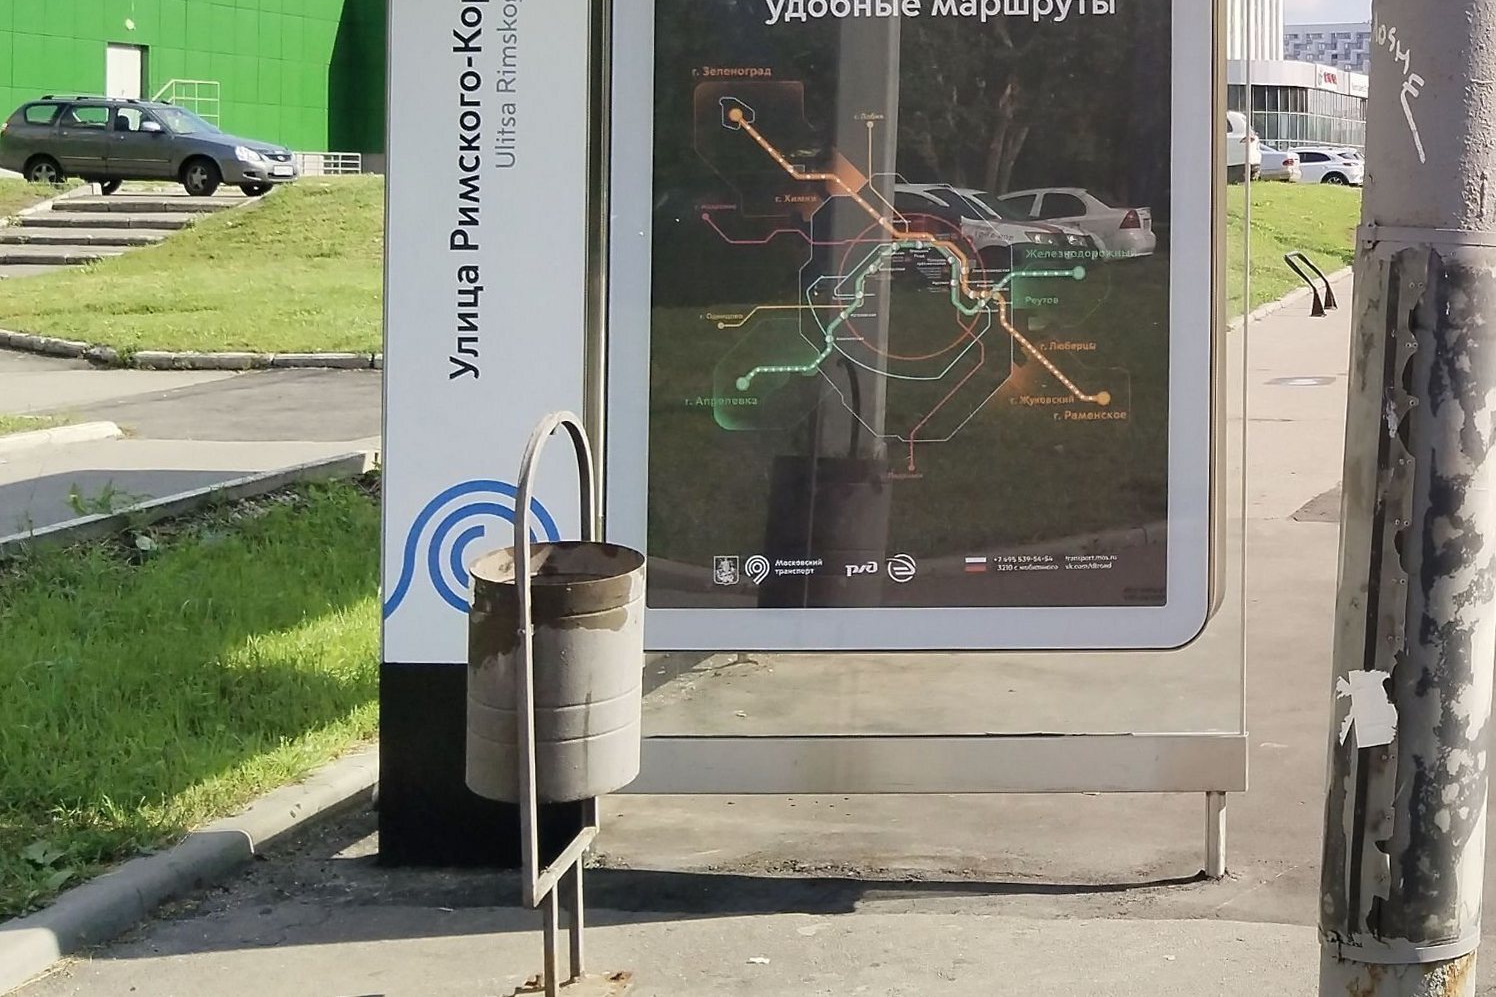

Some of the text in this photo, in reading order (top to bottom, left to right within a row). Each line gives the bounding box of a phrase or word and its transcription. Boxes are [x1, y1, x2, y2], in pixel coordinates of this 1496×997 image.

[702, 66, 772, 78] Зеленоград
[495, 101, 517, 170] Ulitsa
[449, 263, 484, 380] Улица
[1049, 341, 1097, 352] Люберцы
[1019, 394, 1075, 406] Жуковский
[1064, 409, 1127, 420] Раменское
[775, 558, 823, 567] Московский
[775, 567, 815, 576] транспорт
